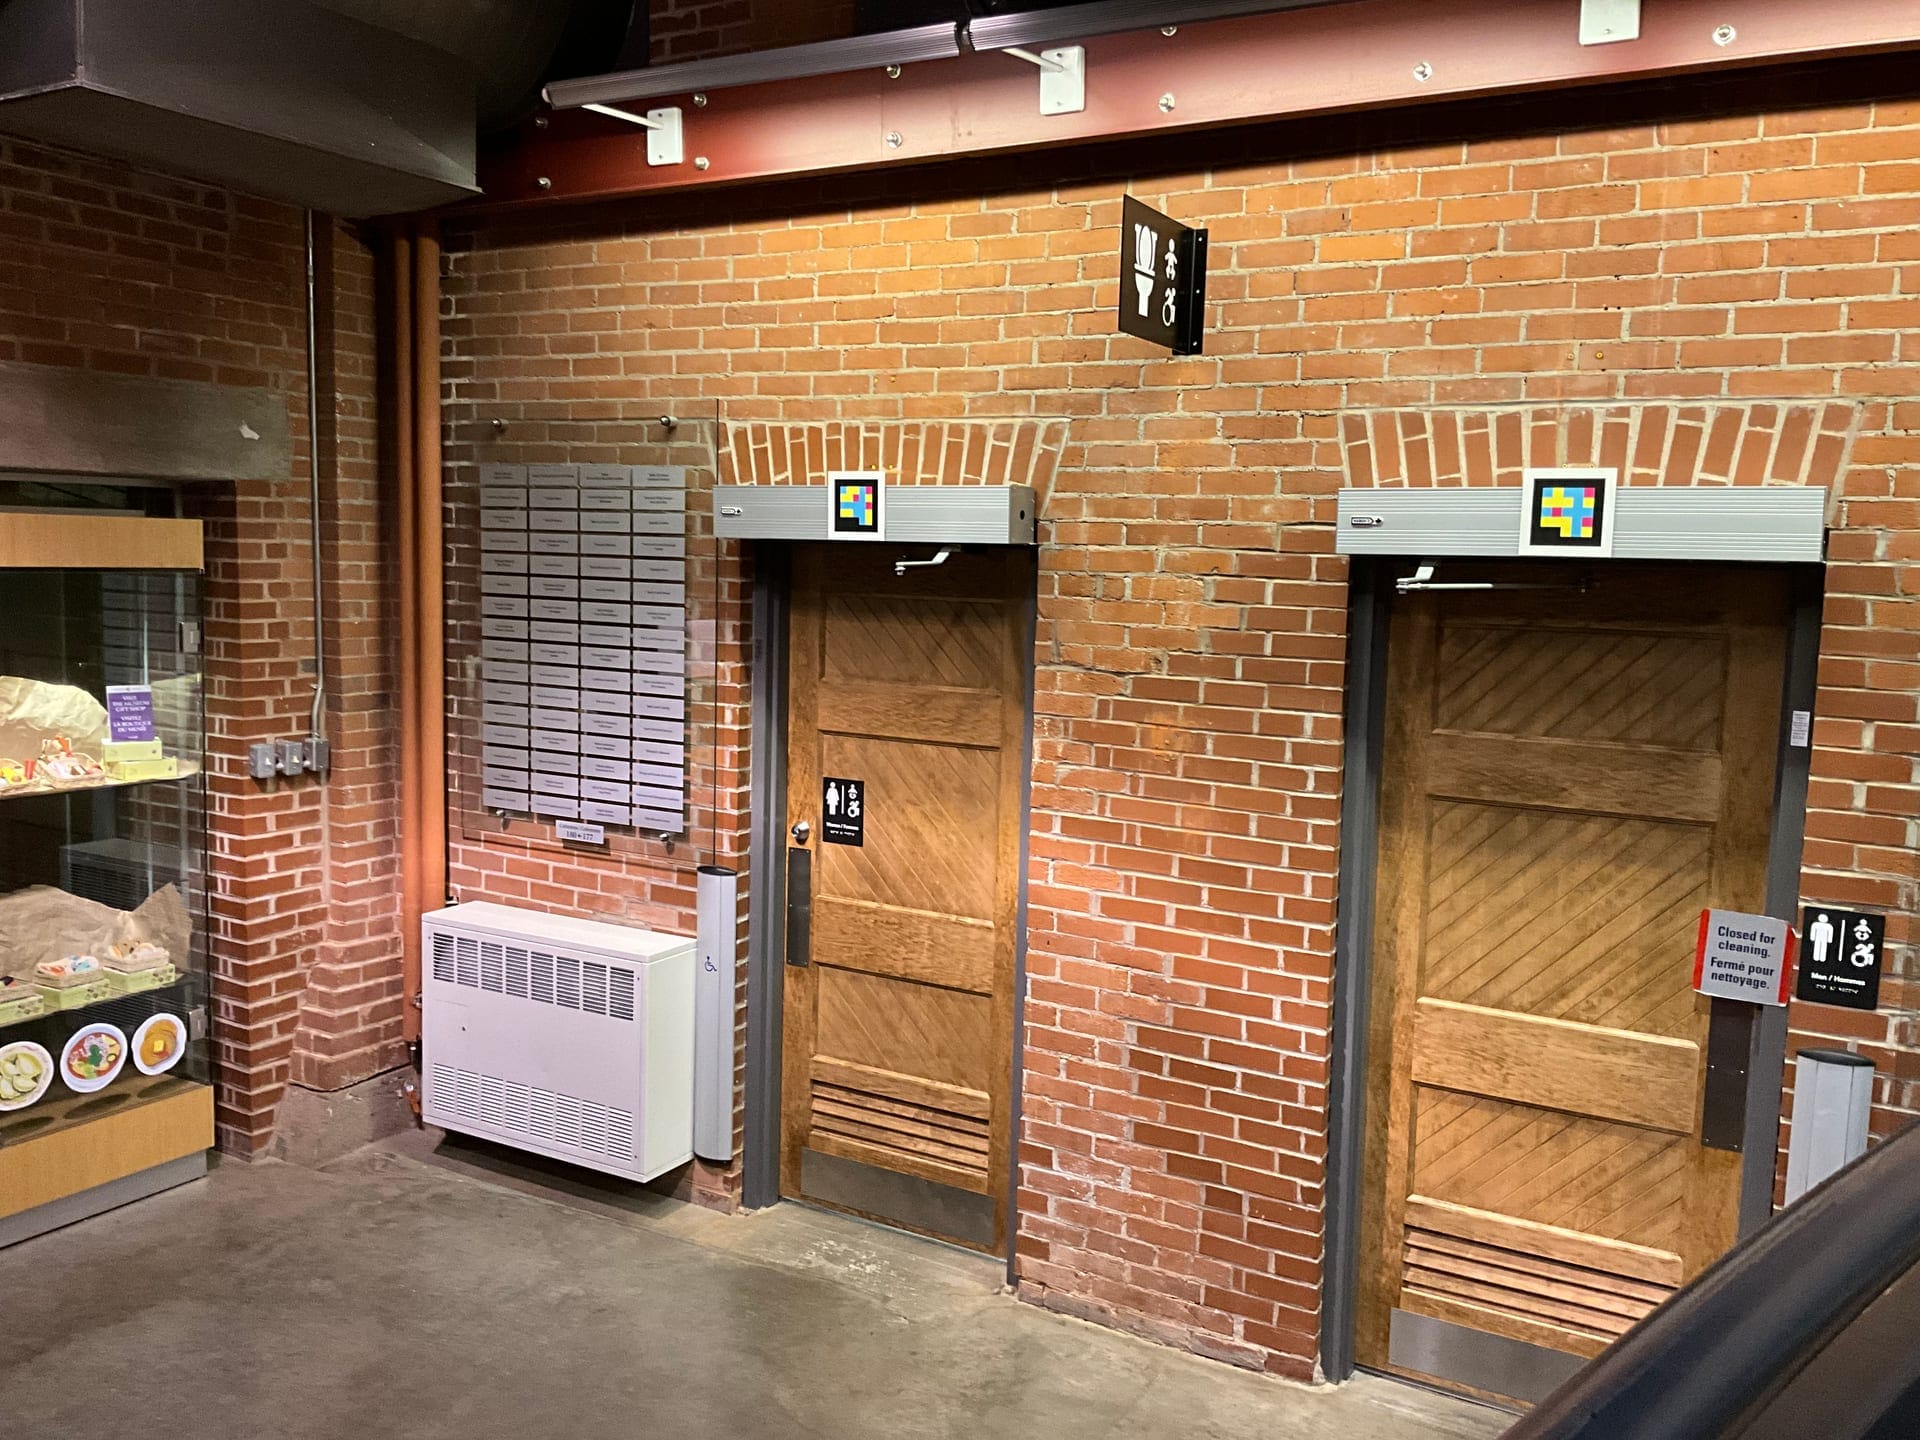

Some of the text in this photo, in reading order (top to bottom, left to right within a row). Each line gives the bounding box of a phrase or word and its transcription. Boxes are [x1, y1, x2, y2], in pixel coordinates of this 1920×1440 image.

[1717, 925, 1776, 945] Closed for
[1718, 939, 1771, 959] cleaning.
[1710, 956, 1775, 977] Fermé pour
[1711, 971, 1770, 990] nettoyage.
